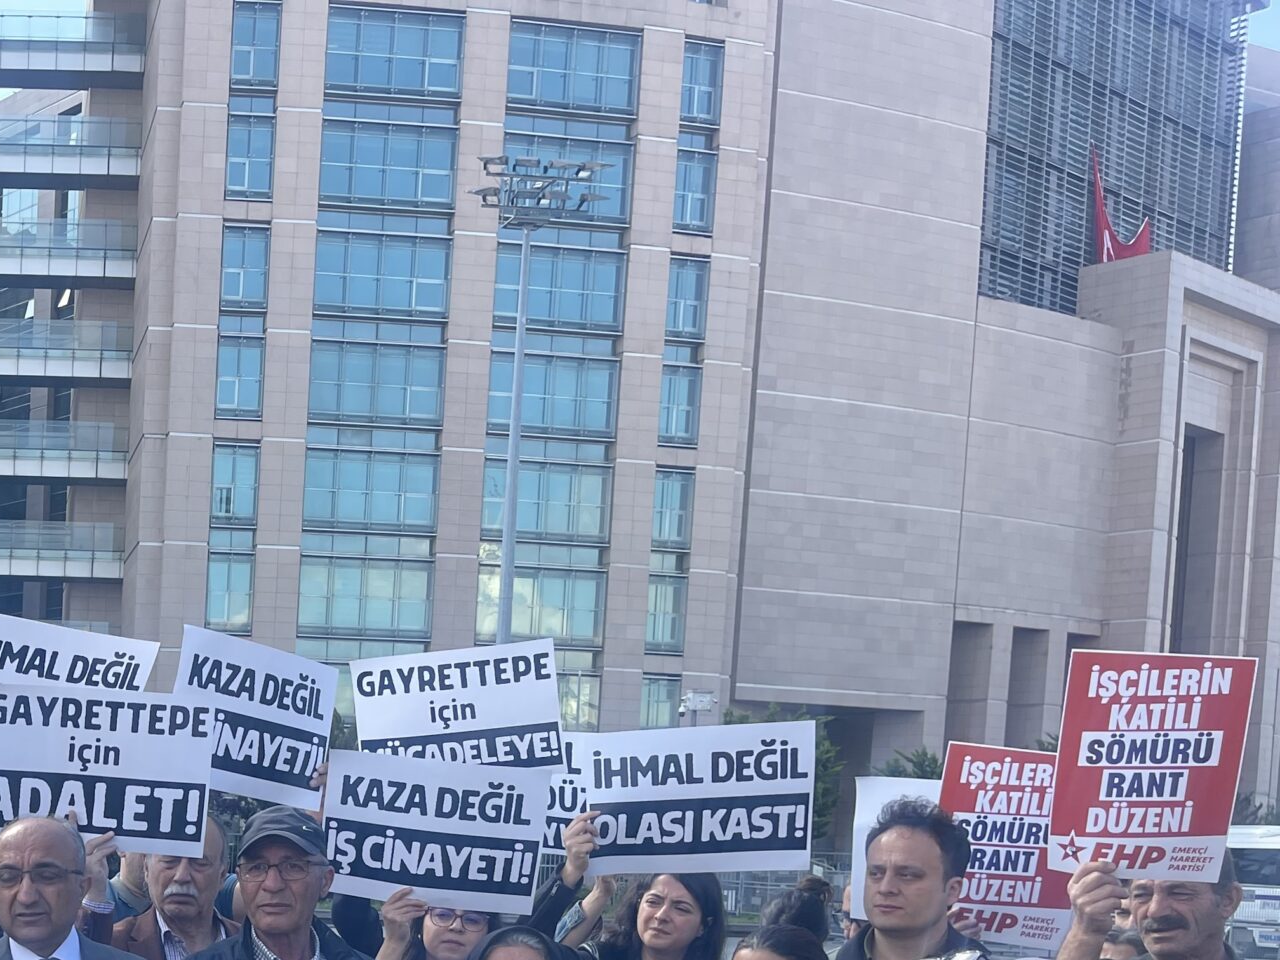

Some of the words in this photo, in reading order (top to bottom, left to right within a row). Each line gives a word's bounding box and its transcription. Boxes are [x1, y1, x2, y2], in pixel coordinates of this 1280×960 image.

[66, 652, 140, 691] DEĞİL
[188, 653, 255, 701] KAZA
[260, 673, 324, 720] DEĞİL
[357, 652, 551, 697] GAYRETTEPE
[1088, 661, 1233, 704] İŞÇİLERİN
[429, 698, 476, 729] için
[1108, 696, 1202, 731] KATİLİ
[68, 736, 120, 772] için
[593, 750, 703, 789] İHMAL
[712, 739, 808, 783] DEĞİL
[1086, 732, 1215, 765] SÖMÜRÜ
[340, 774, 430, 816] KAZA
[434, 782, 531, 826] DEĞİL
[1105, 771, 1184, 798] RANT
[975, 788, 1053, 816] KATİLİ
[1086, 801, 1193, 834] DÜZENİ
[597, 810, 695, 846] OLASI
[701, 805, 805, 841] KAST!
[326, 822, 356, 874] İŞ
[362, 834, 533, 884] CİNAYETİ!
[969, 848, 1035, 873] RANT
[1172, 846, 1207, 855] EMEKÇİ
[1168, 864, 1204, 872] PARTİSİ
[1020, 932, 1052, 940] PARTİSİ
[1022, 924, 1060, 933] HAREKET
[1023, 916, 1055, 925] EMEKÇİ
